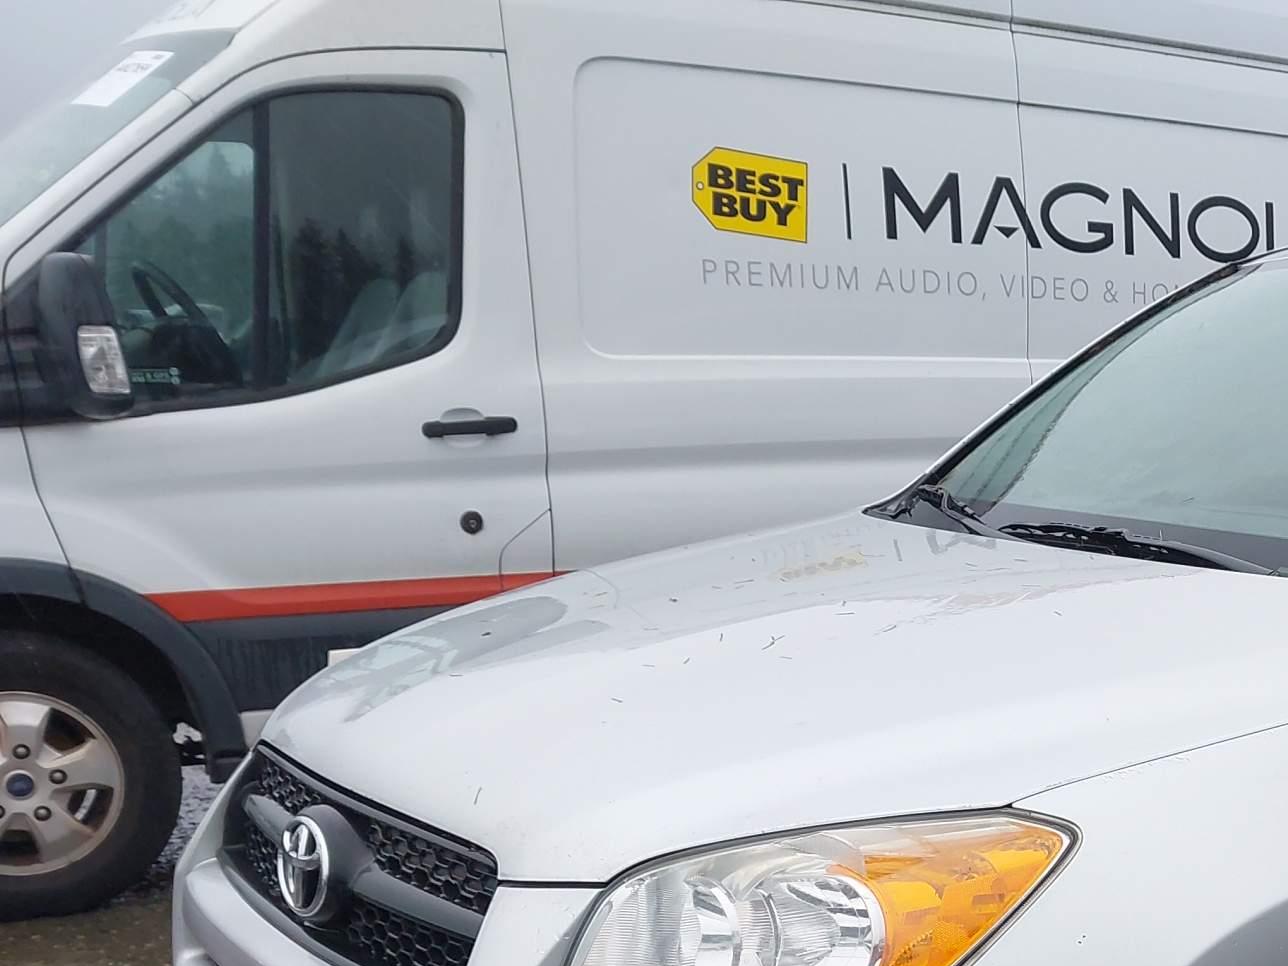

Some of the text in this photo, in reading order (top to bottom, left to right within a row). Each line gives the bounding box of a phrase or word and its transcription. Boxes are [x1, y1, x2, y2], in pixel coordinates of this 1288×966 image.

[708, 163, 804, 202] BEST
[712, 191, 797, 226] BUY
[701, 258, 859, 291] PREMIUM
[875, 267, 987, 301] AUDIO,
[1000, 273, 1089, 302] VIDEO
[1103, 279, 1119, 304] &
